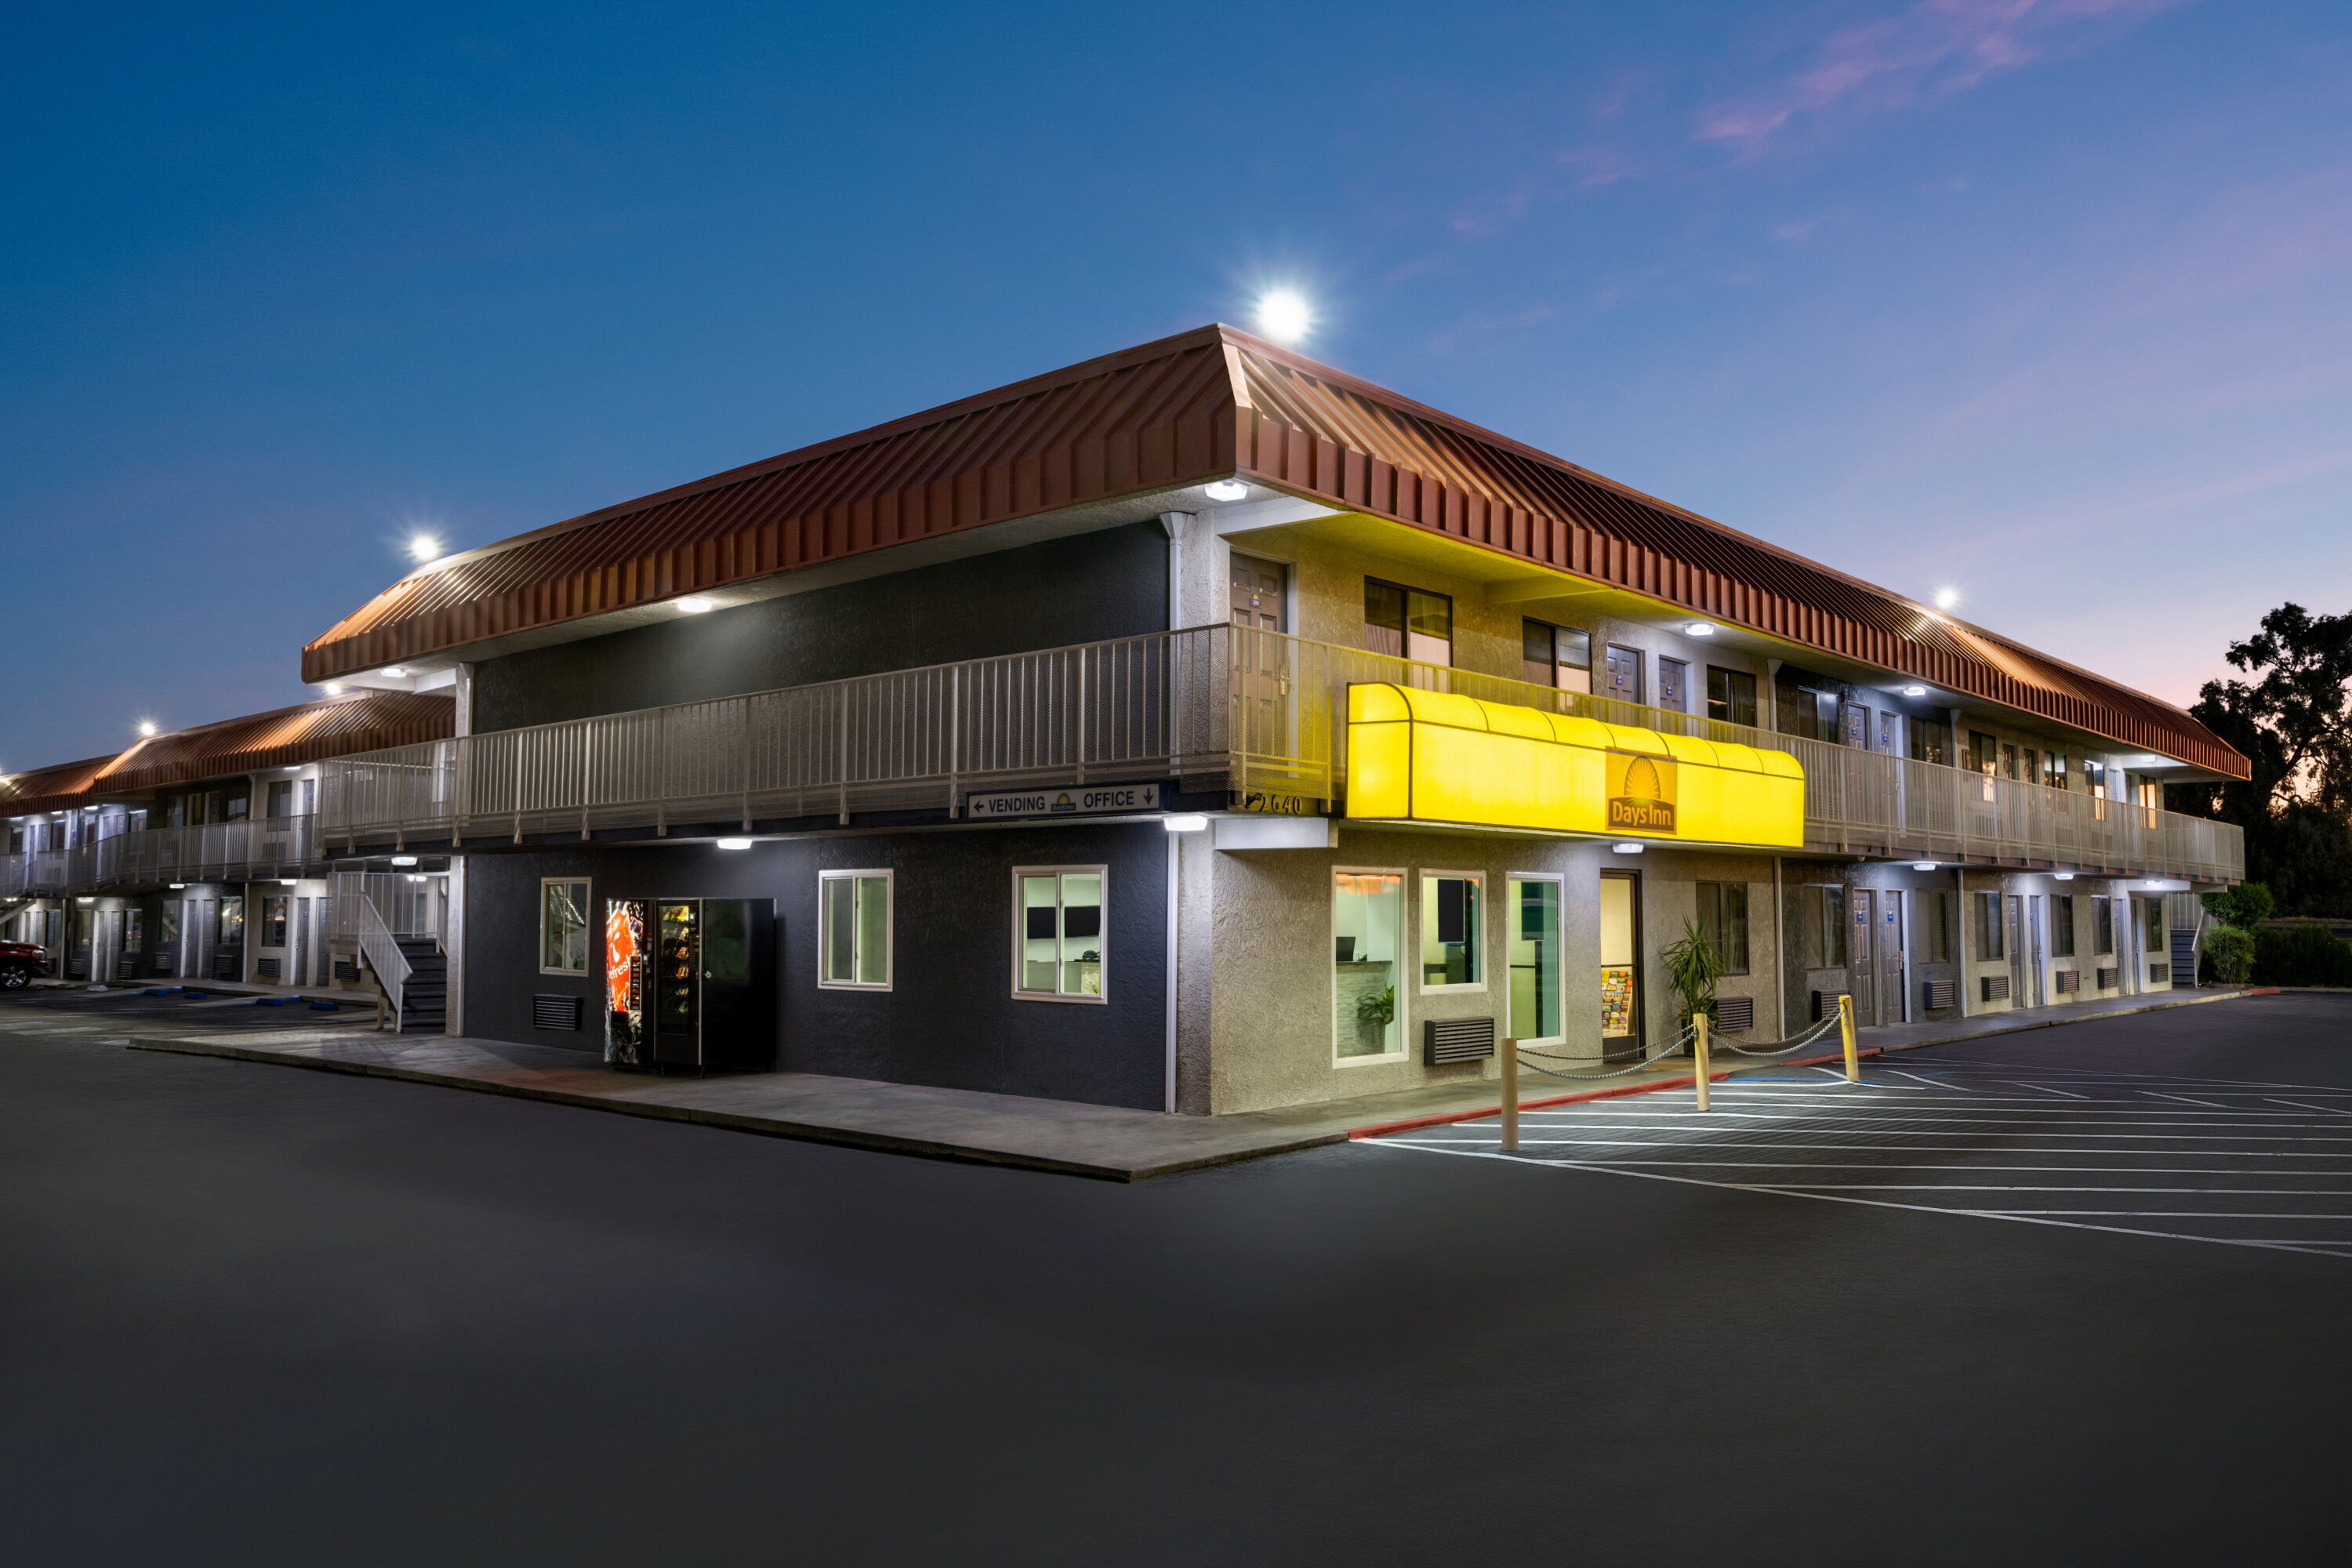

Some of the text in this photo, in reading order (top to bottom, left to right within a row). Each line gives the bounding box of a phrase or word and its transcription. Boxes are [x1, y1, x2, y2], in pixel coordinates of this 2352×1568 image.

[989, 796, 1045, 813] VENDING
[1083, 790, 1134, 808] OFFICE
[1259, 793, 1302, 815] 2640
[1613, 800, 1671, 826] Days Inn
